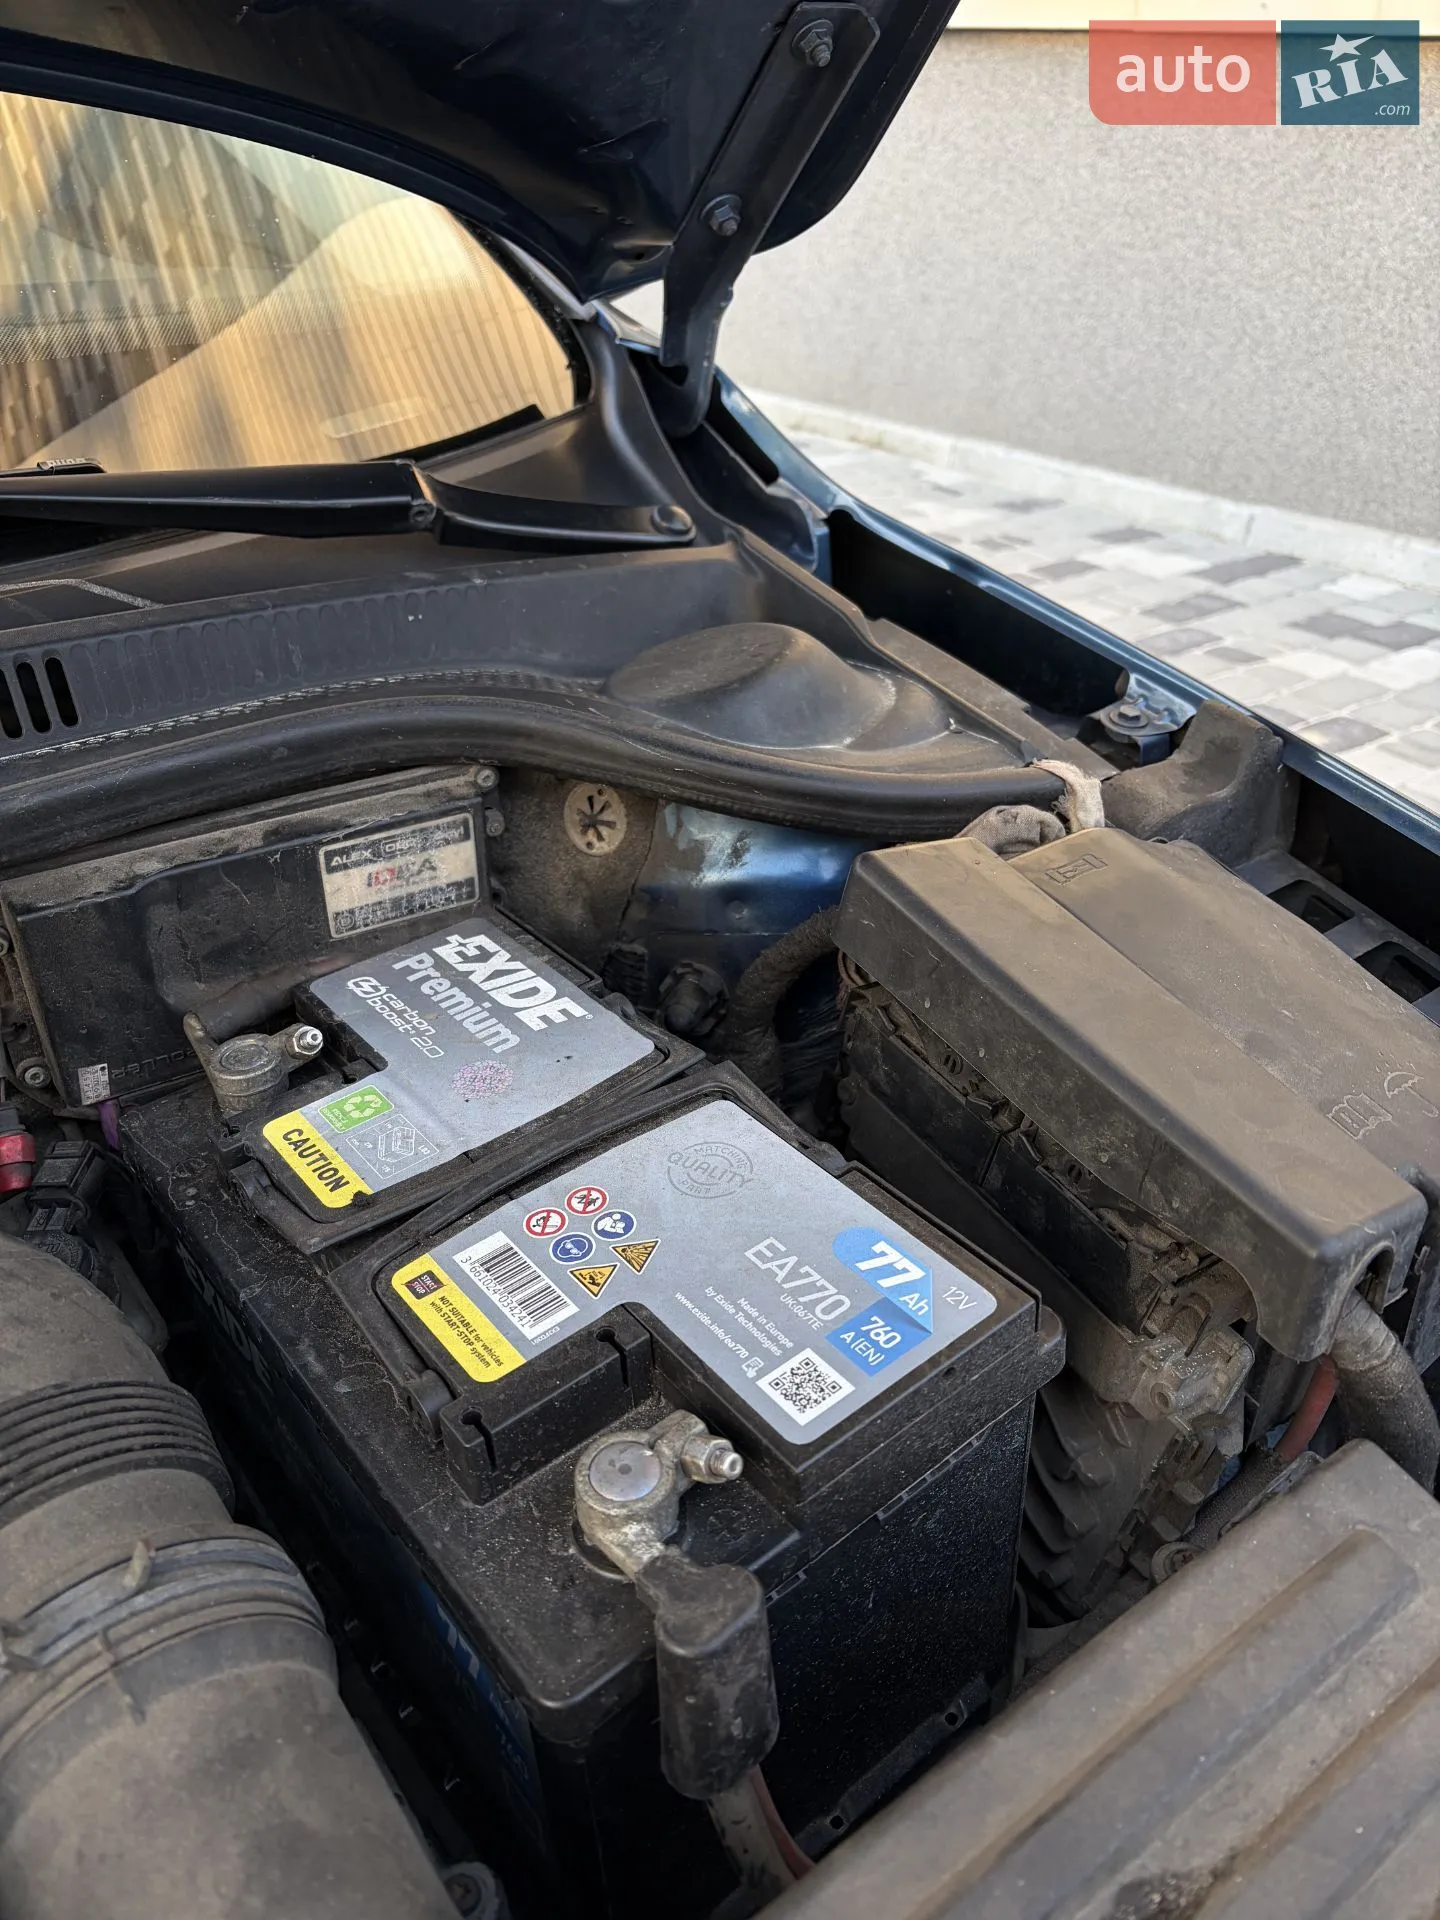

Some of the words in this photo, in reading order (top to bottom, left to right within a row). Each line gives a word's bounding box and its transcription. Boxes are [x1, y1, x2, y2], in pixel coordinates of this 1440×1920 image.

[391, 953, 521, 1054] Premium
[432, 934, 590, 1032] EXIDE
[366, 996, 414, 1033] boost
[382, 993, 437, 1036] carbon
[282, 1128, 350, 1193] CAUTION
[667, 1151, 755, 1188] QUALITY
[694, 1145, 749, 1172] MATCHING
[460, 1255, 472, 1264] 3
[744, 1236, 851, 1321] EA770
[855, 1240, 927, 1288] 77
[898, 1292, 930, 1316] Ah
[674, 1291, 749, 1359] www.exide.info/ea770
[704, 1286, 718, 1297] by
[714, 1294, 736, 1314] Exide
[734, 1311, 783, 1356] Technologies
[737, 1297, 759, 1318] Made
[756, 1315, 767, 1325] in
[764, 1321, 794, 1349] Europe
[779, 1293, 824, 1331] UK:067TE
[941, 1285, 978, 1311] 12V
[429, 1301, 443, 1314] with
[440, 1312, 475, 1347] START-STOP
[470, 1346, 491, 1368] system
[438, 1295, 452, 1308] NOT
[448, 1306, 477, 1336] SUITABLE
[473, 1333, 484, 1344] for
[481, 1341, 504, 1367] vehicles
[860, 1315, 902, 1349] 760
